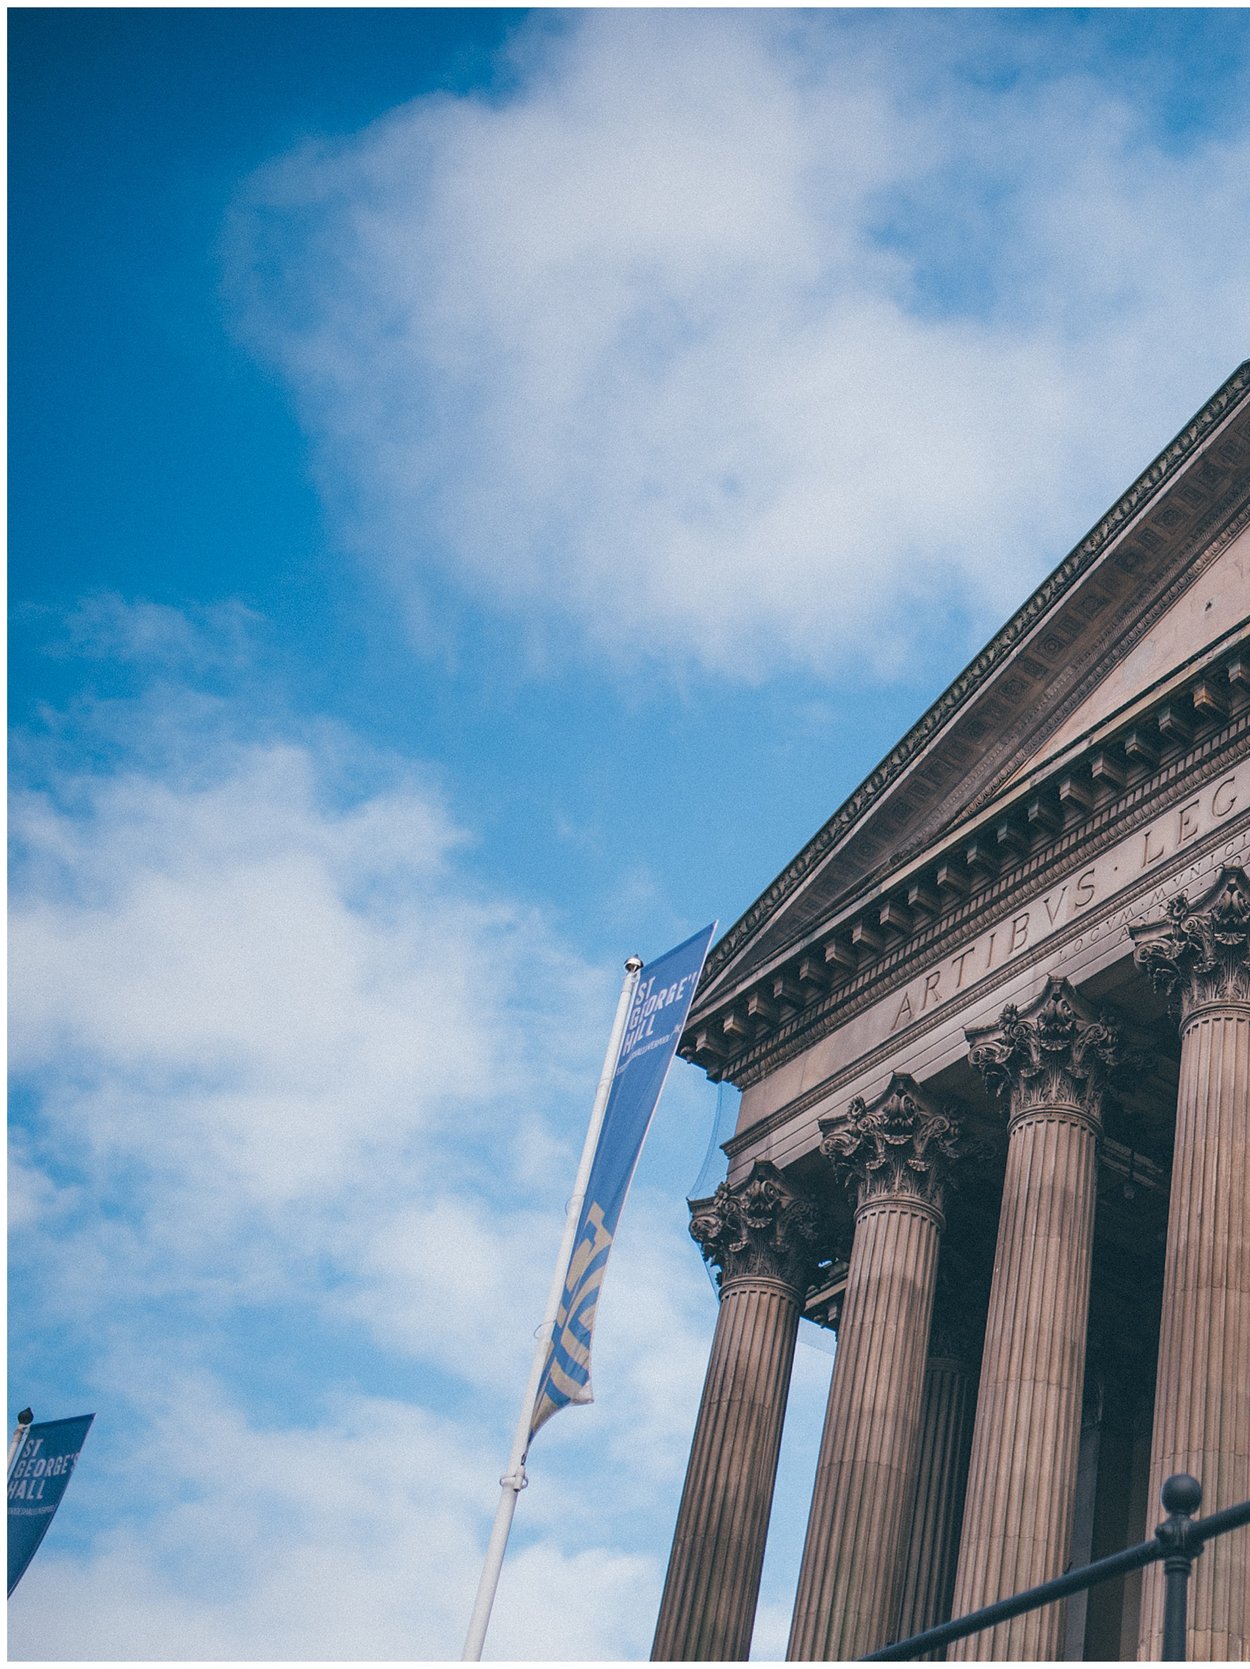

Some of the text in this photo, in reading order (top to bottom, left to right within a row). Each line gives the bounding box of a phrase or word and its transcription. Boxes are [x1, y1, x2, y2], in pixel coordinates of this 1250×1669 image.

[890, 868, 1096, 1031] ARTIBVS
[1058, 907, 1135, 963] LOCVM
[636, 976, 656, 1006] ST
[22, 1439, 44, 1458] ST
[8, 1479, 46, 1500] HALL
